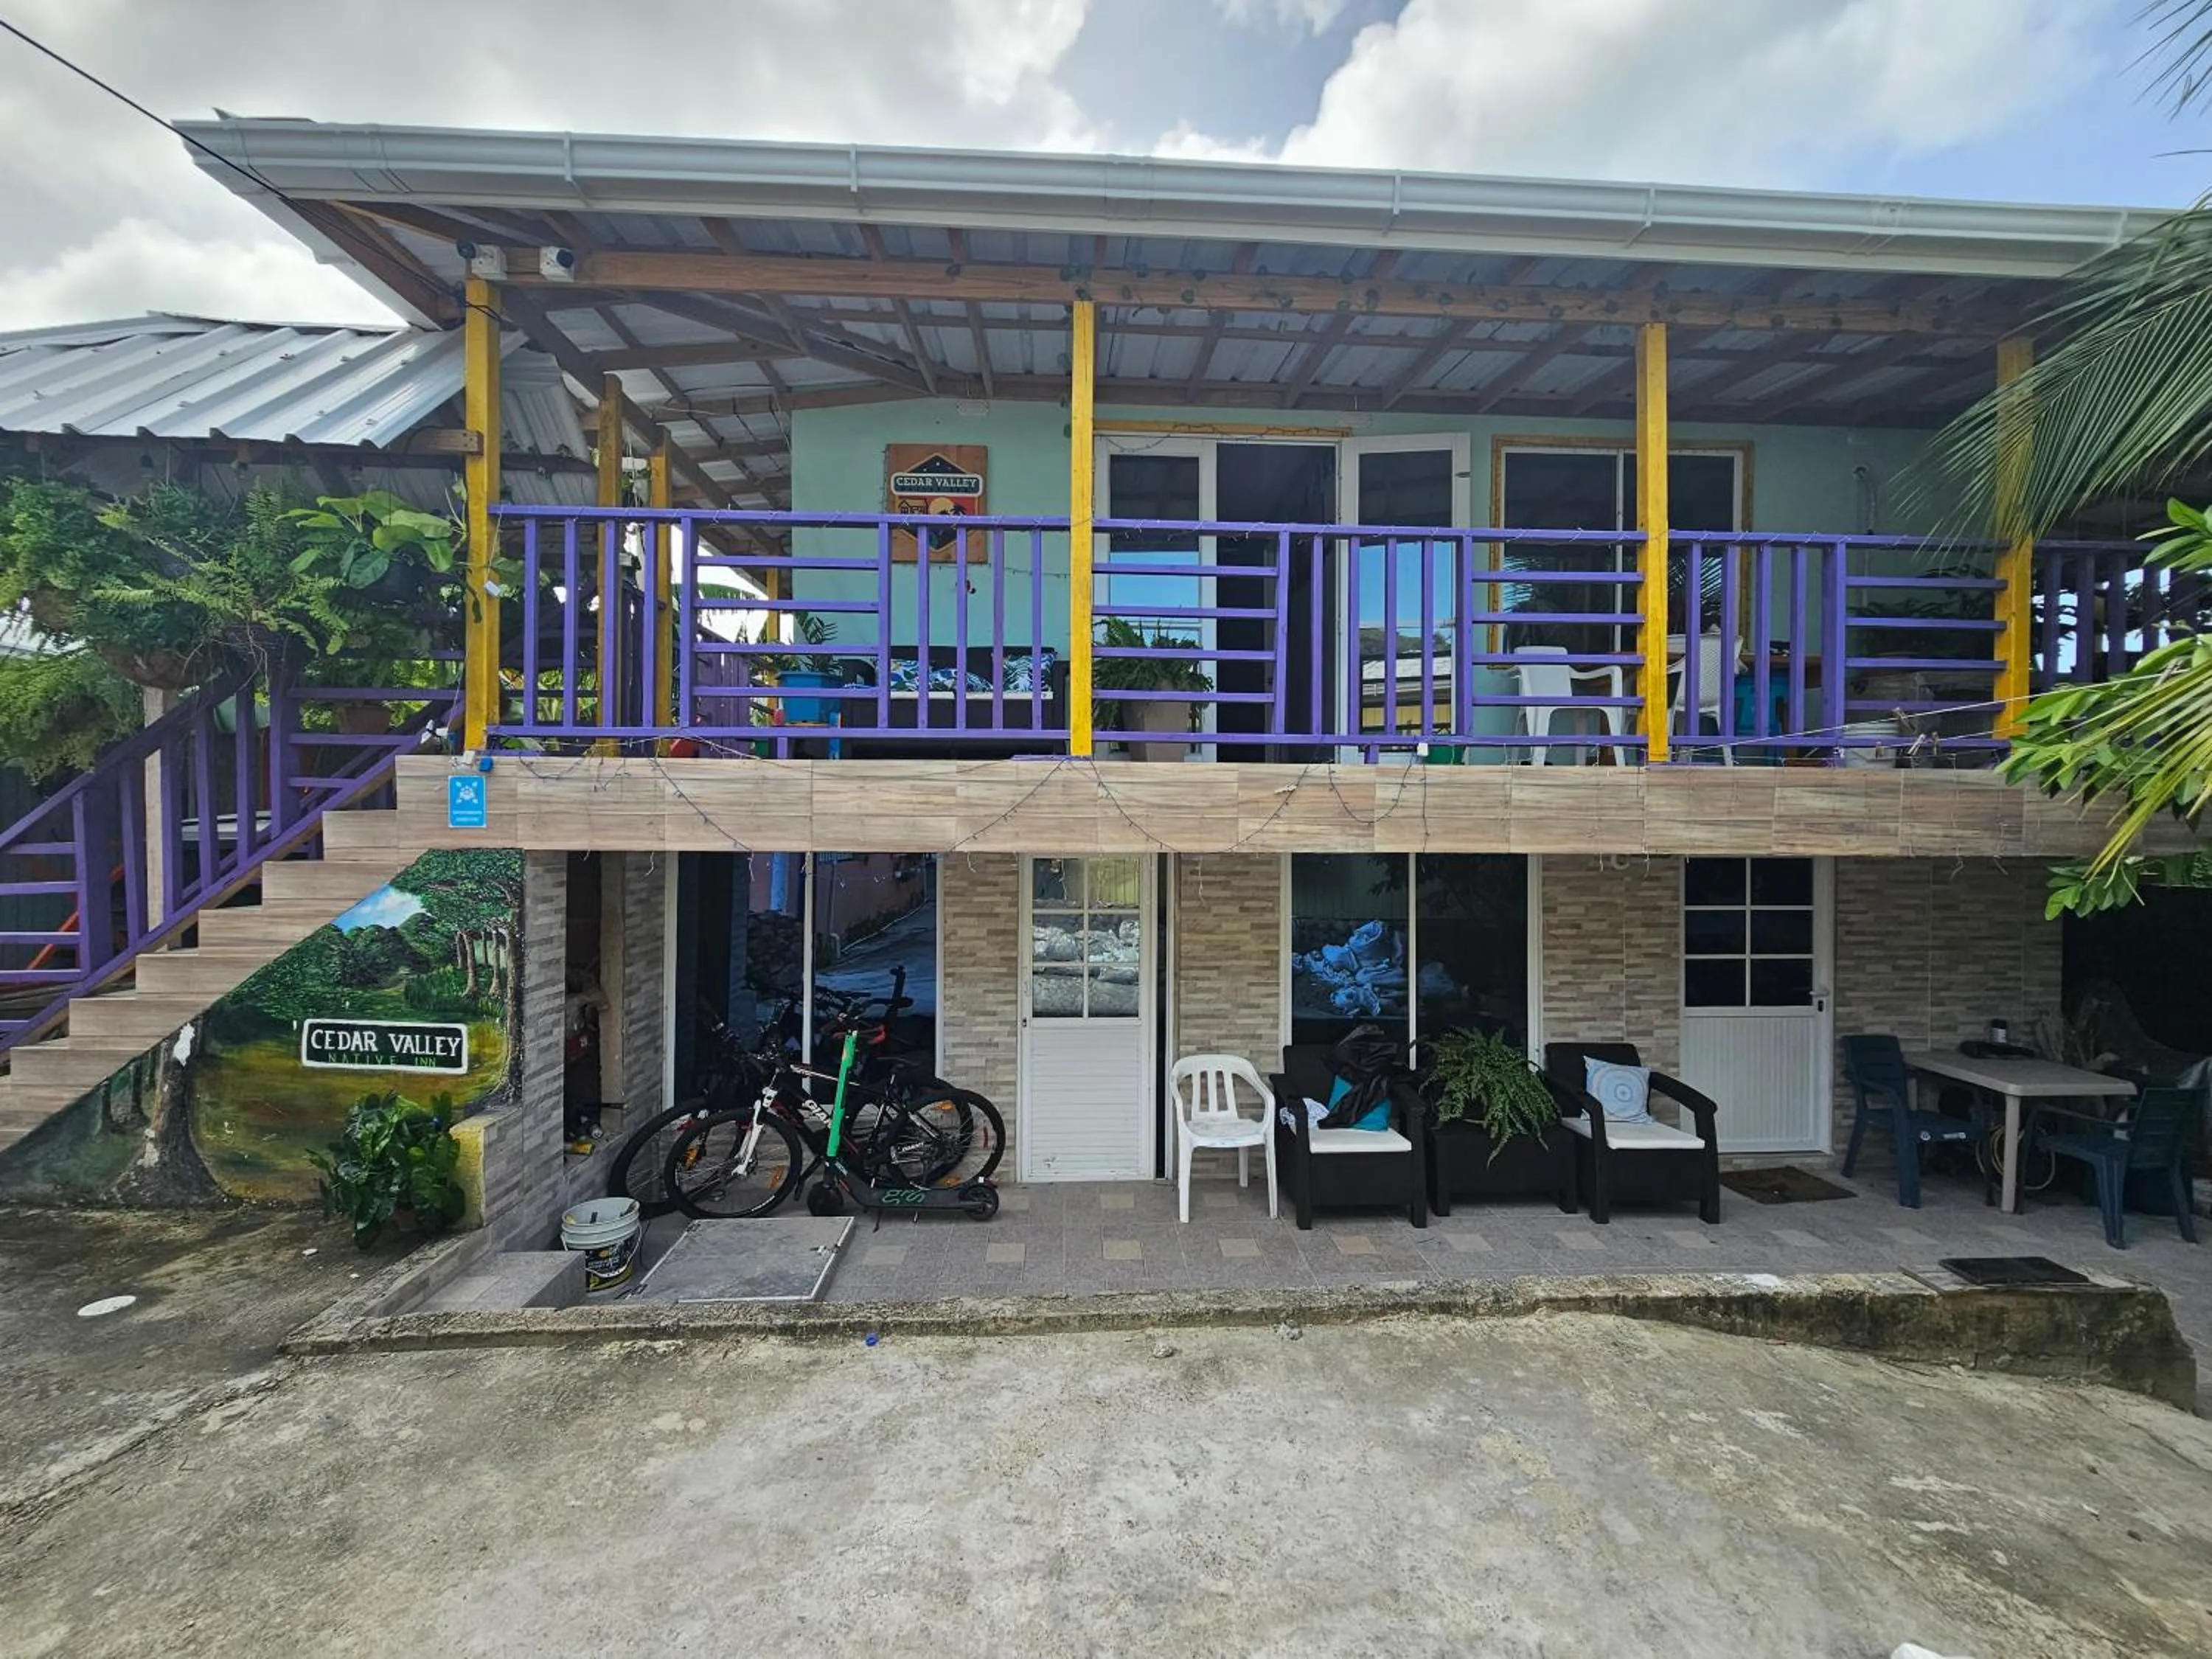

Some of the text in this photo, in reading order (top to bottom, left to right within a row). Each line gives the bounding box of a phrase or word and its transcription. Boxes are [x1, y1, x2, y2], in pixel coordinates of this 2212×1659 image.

[896, 477, 977, 488] CEDAR VALLEY
[310, 1029, 461, 1057] CEDAR VALLEY
[328, 1053, 437, 1068] NATIVE INN
